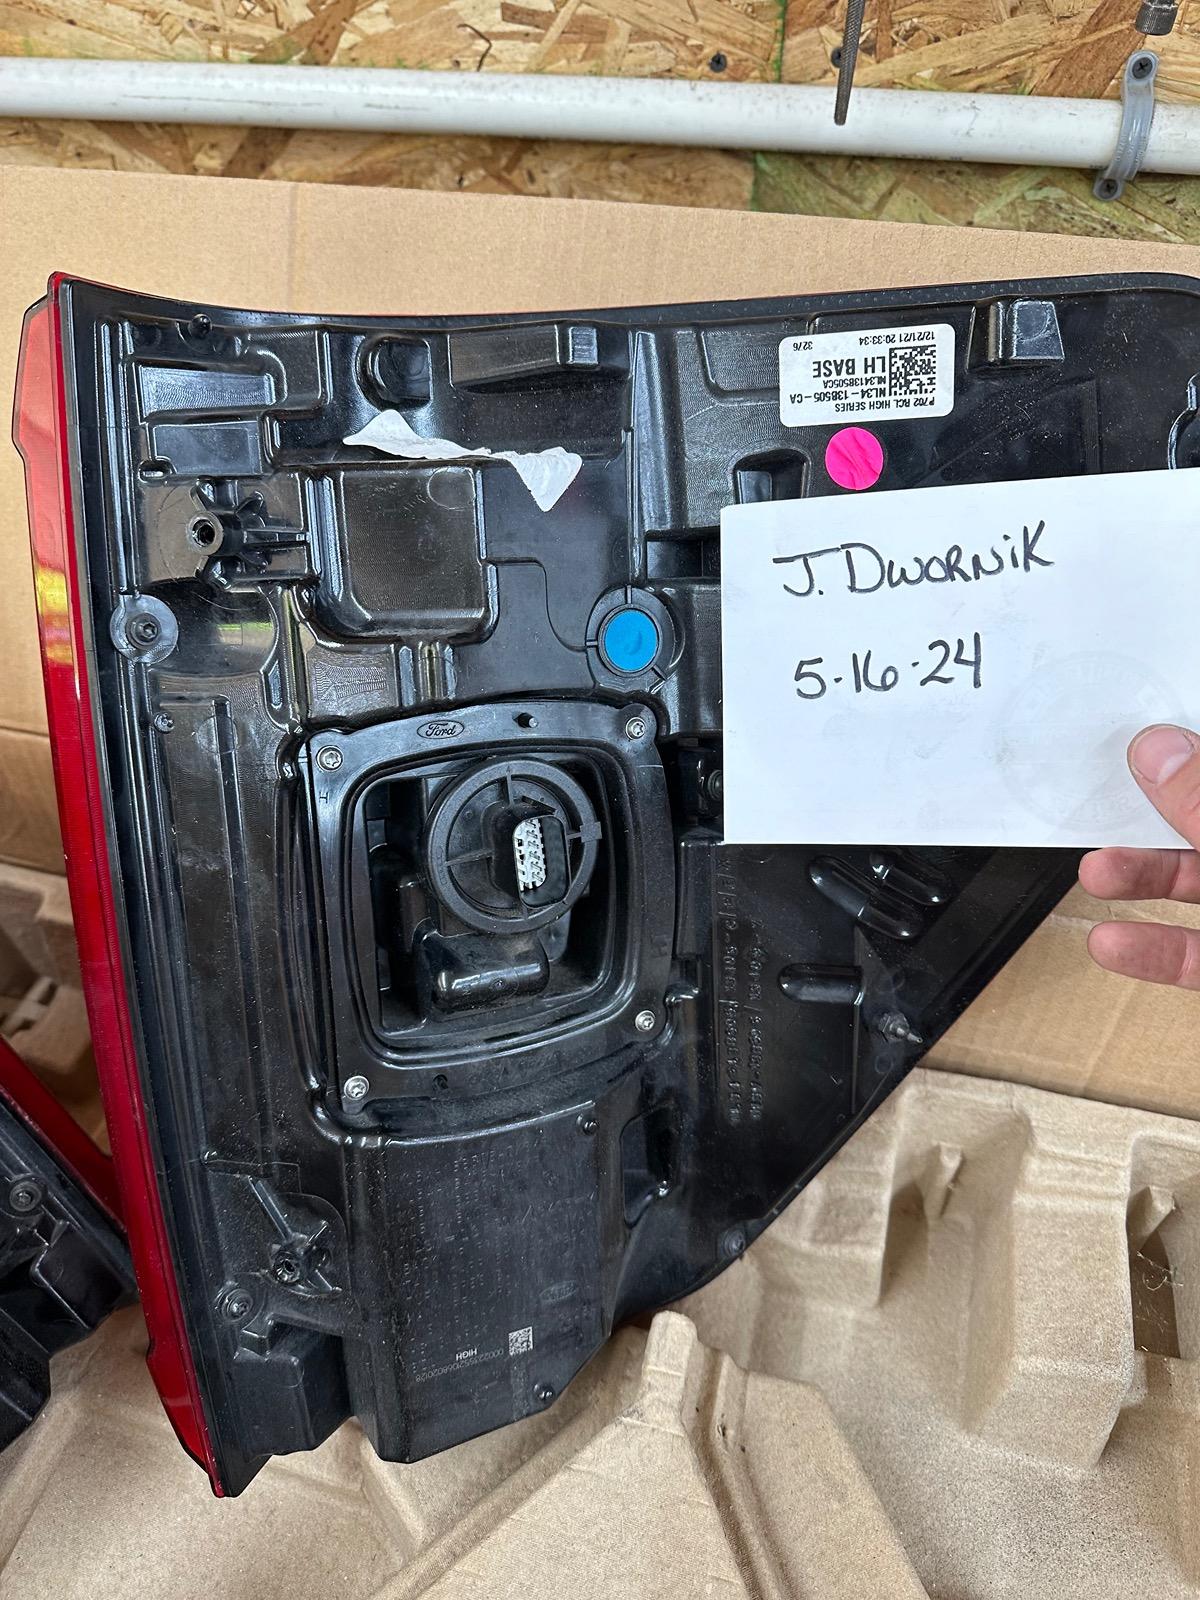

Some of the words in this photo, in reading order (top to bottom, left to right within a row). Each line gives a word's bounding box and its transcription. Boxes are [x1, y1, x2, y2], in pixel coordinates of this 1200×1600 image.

[858, 333, 896, 346] 20:33:34
[899, 331, 935, 343] 12/21/21
[792, 341, 813, 351] 3276
[812, 357, 856, 378] BASE
[863, 355, 886, 374] LH
[822, 375, 886, 389] NL3413B505CA
[834, 401, 866, 412] SERIES
[868, 400, 891, 410] HIGH
[894, 398, 911, 408] RCL
[913, 396, 935, 407] P702
[425, 721, 456, 737] Ford
[455, 1347, 478, 1360] HIGH
